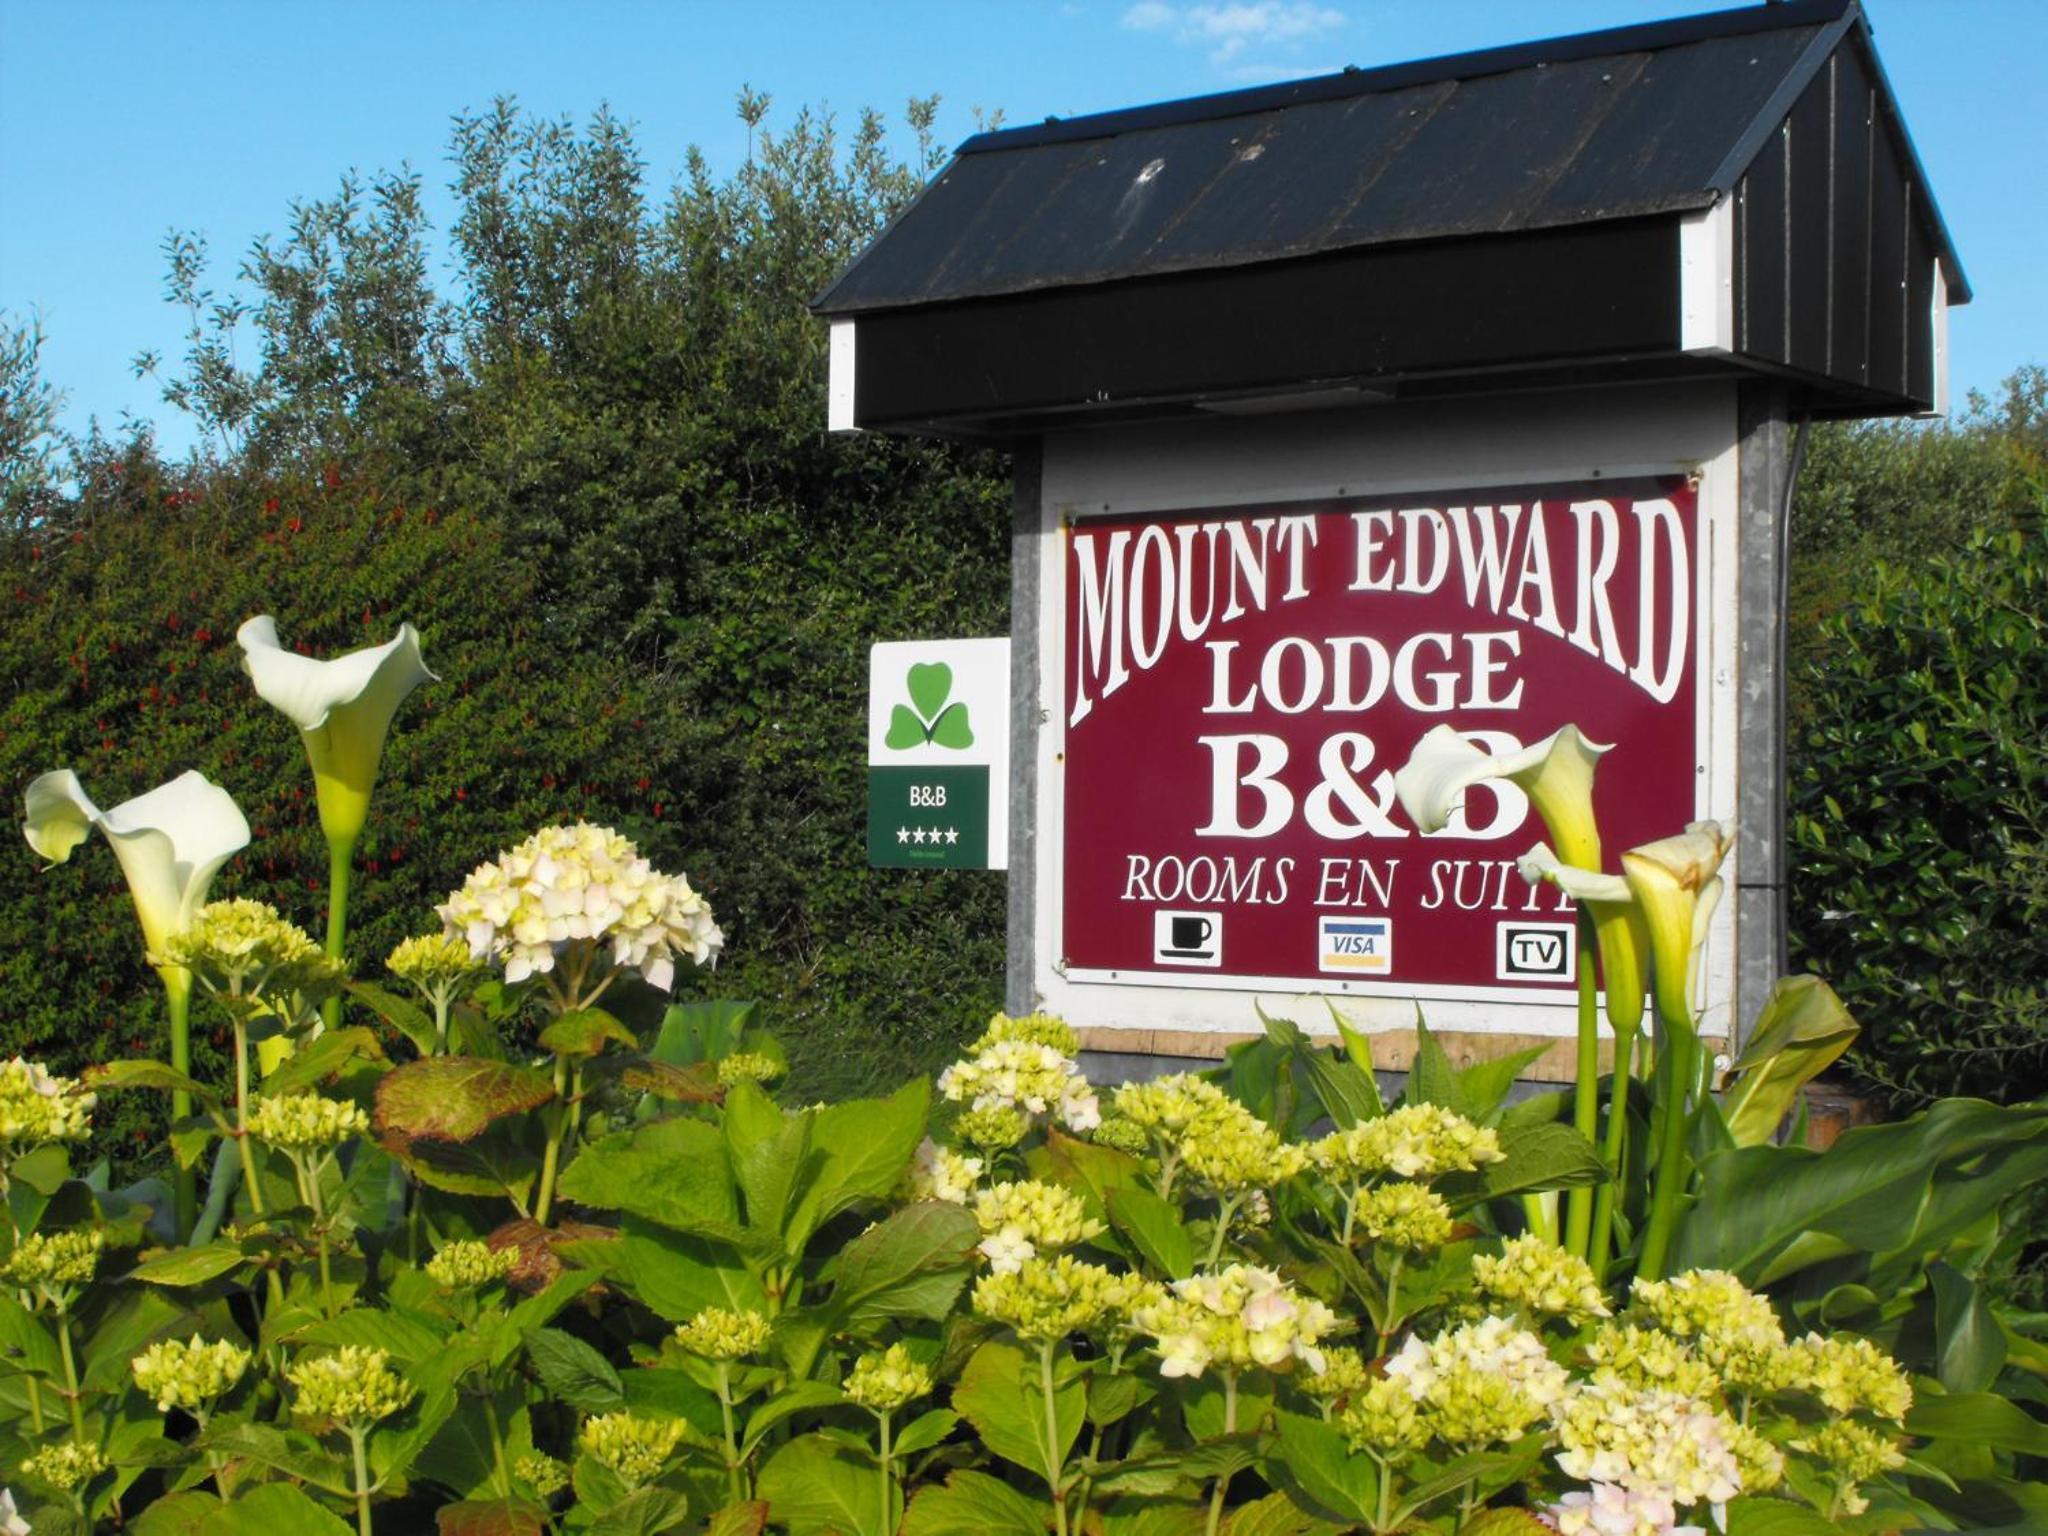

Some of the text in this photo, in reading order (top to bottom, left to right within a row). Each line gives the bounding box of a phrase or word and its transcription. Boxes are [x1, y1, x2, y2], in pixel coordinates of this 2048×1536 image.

[1070, 499, 1690, 729] MOUNT EDWARD
[1202, 630, 1525, 716] LODGE
[910, 785, 947, 807] B&B
[1195, 730, 1529, 841] B&B
[1120, 854, 1579, 913] ROOMS EN SUI
[1332, 936, 1375, 956] VISA
[1515, 940, 1557, 964] TV
